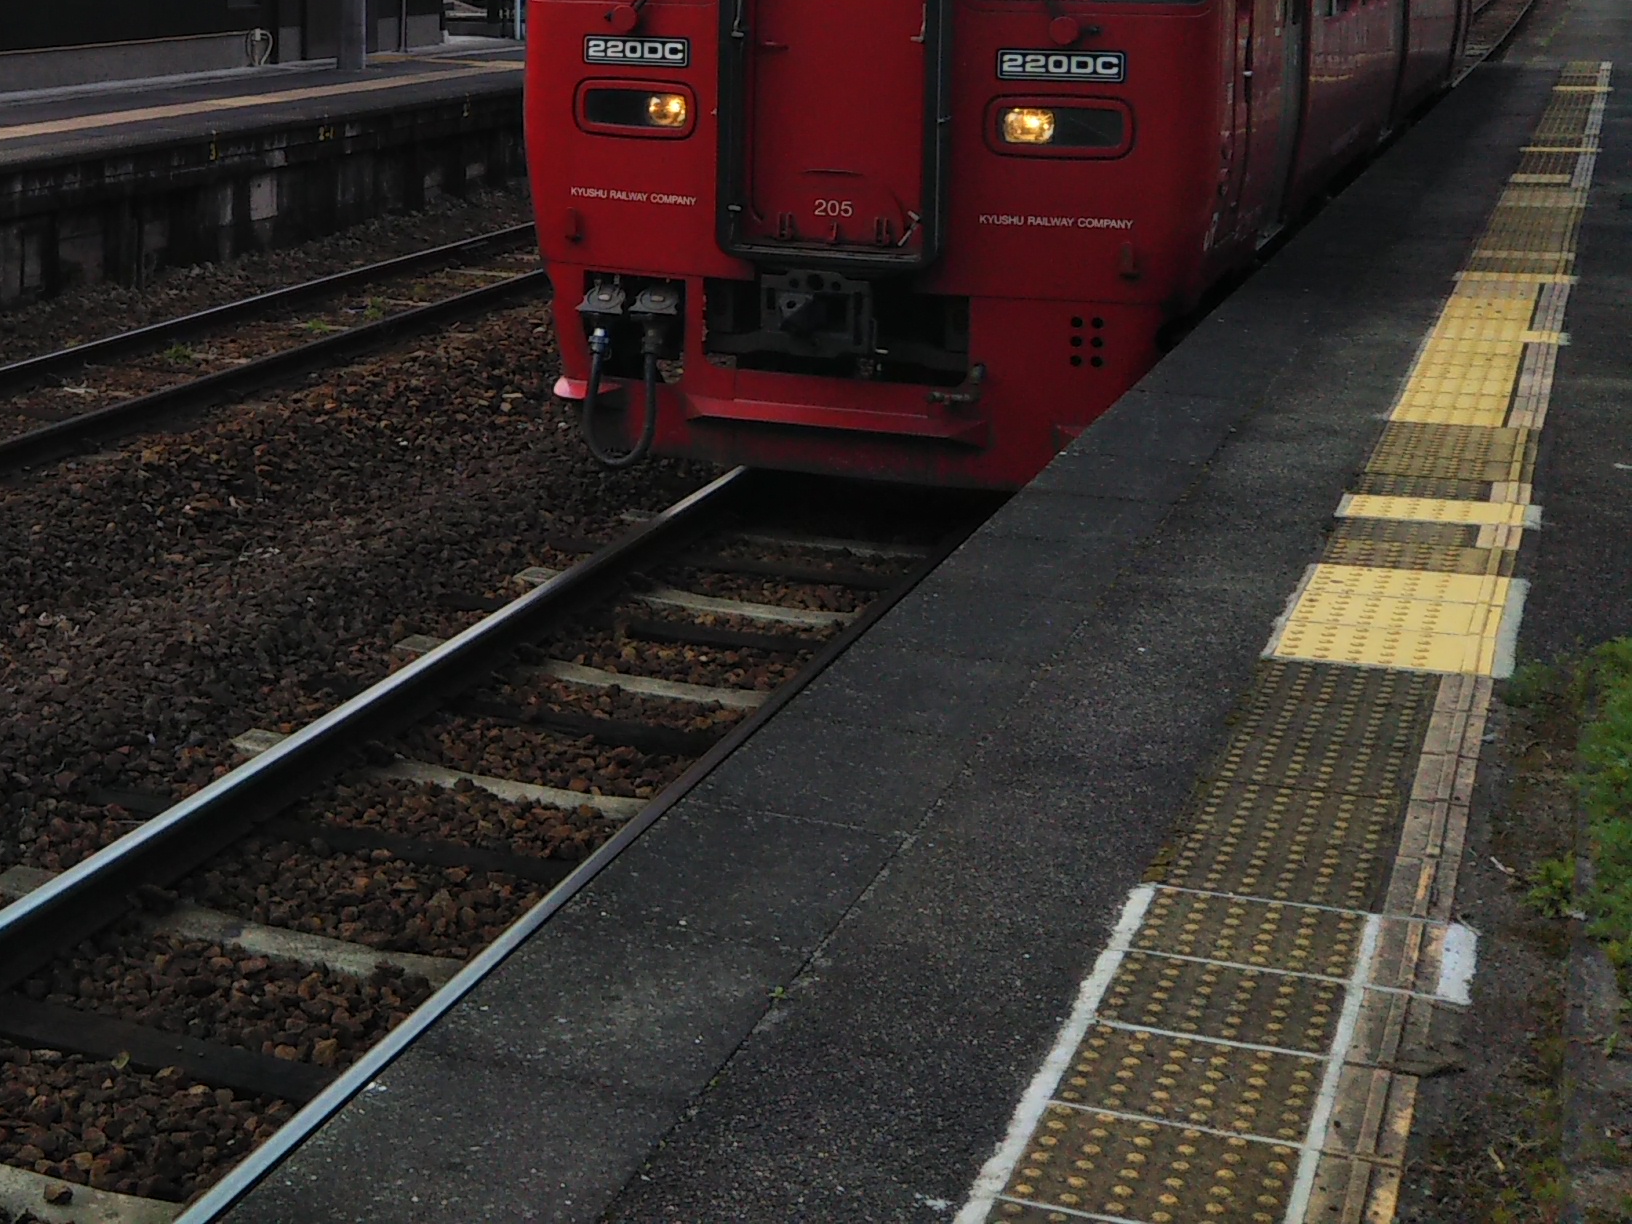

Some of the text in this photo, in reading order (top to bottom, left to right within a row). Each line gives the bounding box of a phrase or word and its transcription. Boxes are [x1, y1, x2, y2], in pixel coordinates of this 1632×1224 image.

[587, 39, 685, 61] 220DC
[1002, 52, 1119, 78] 220DC
[570, 186, 697, 206] KYUSHU RAILWAY COMPANY
[814, 199, 853, 217] 205
[979, 214, 1134, 230] KYUSHU RAILWAY COMPANY
